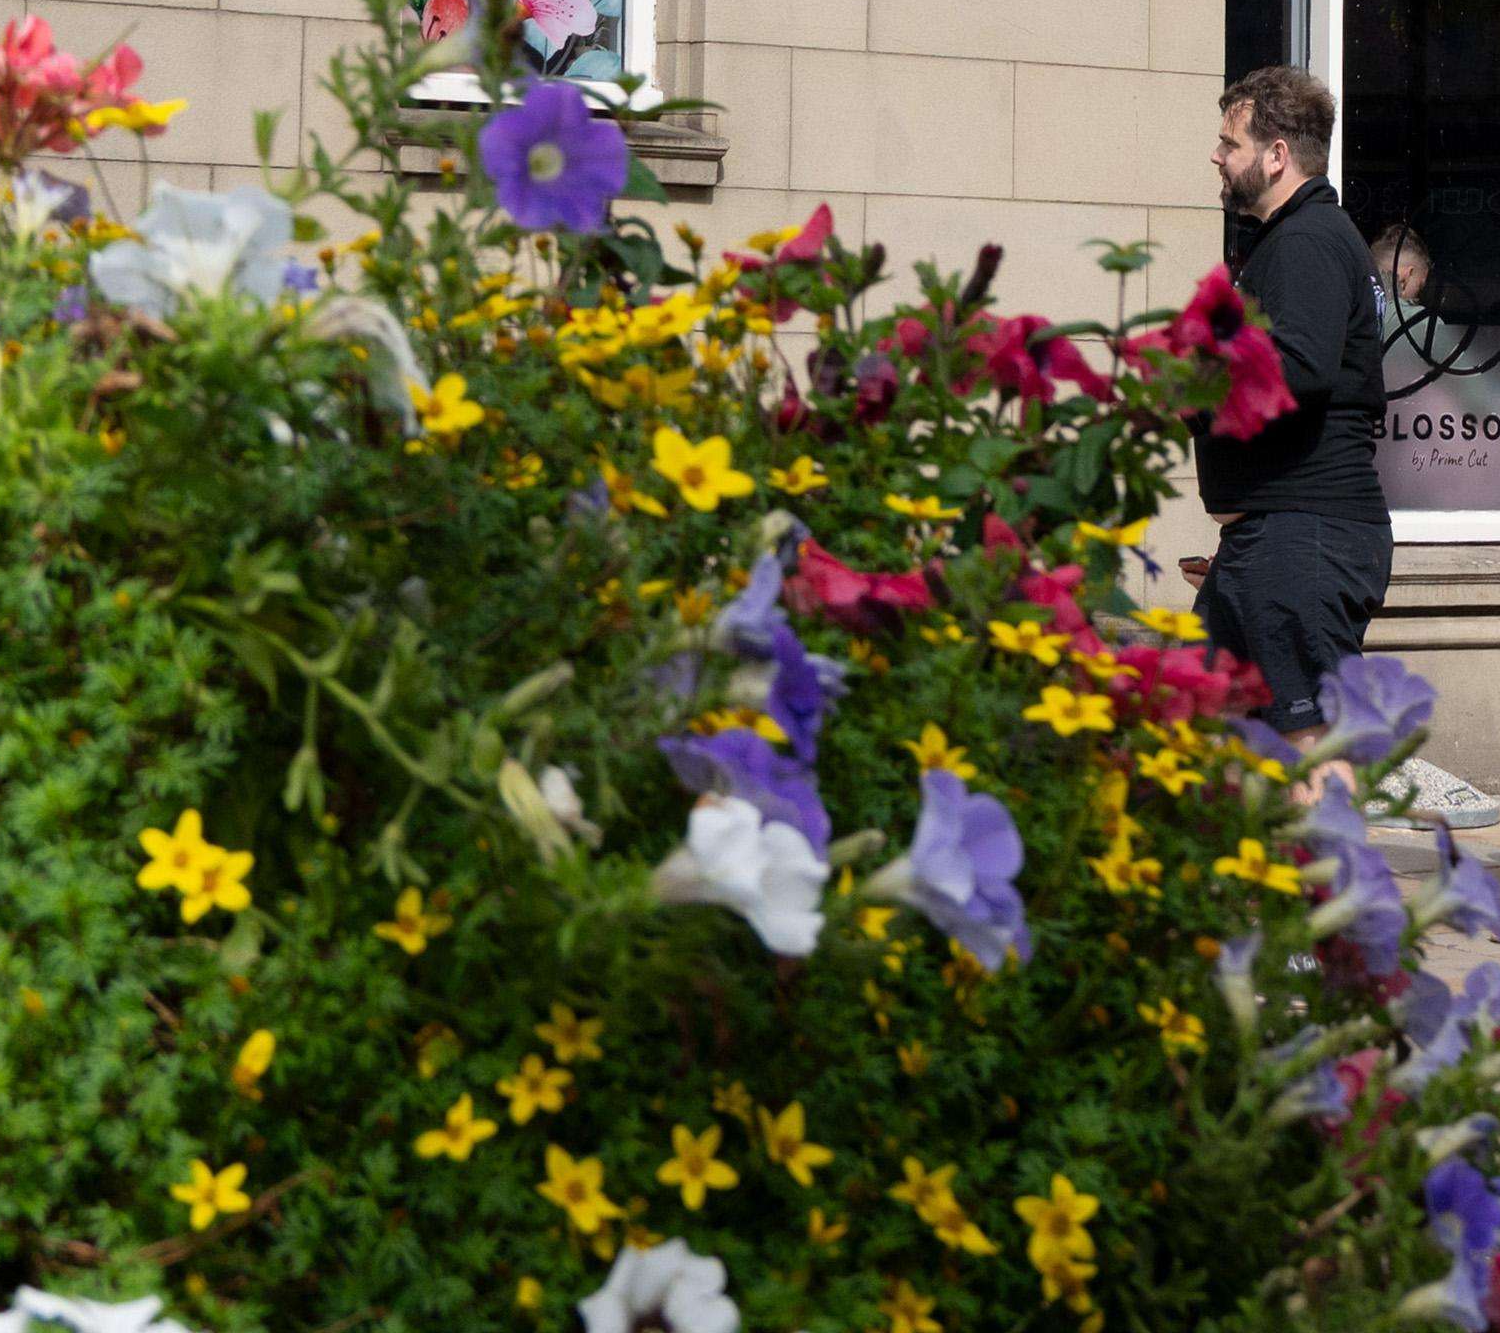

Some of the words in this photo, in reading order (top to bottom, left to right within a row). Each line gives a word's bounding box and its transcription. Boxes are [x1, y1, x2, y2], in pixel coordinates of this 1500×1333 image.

[1411, 450, 1426, 472] by
[1429, 448, 1463, 468] Prime
[1467, 448, 1489, 468] Cut
